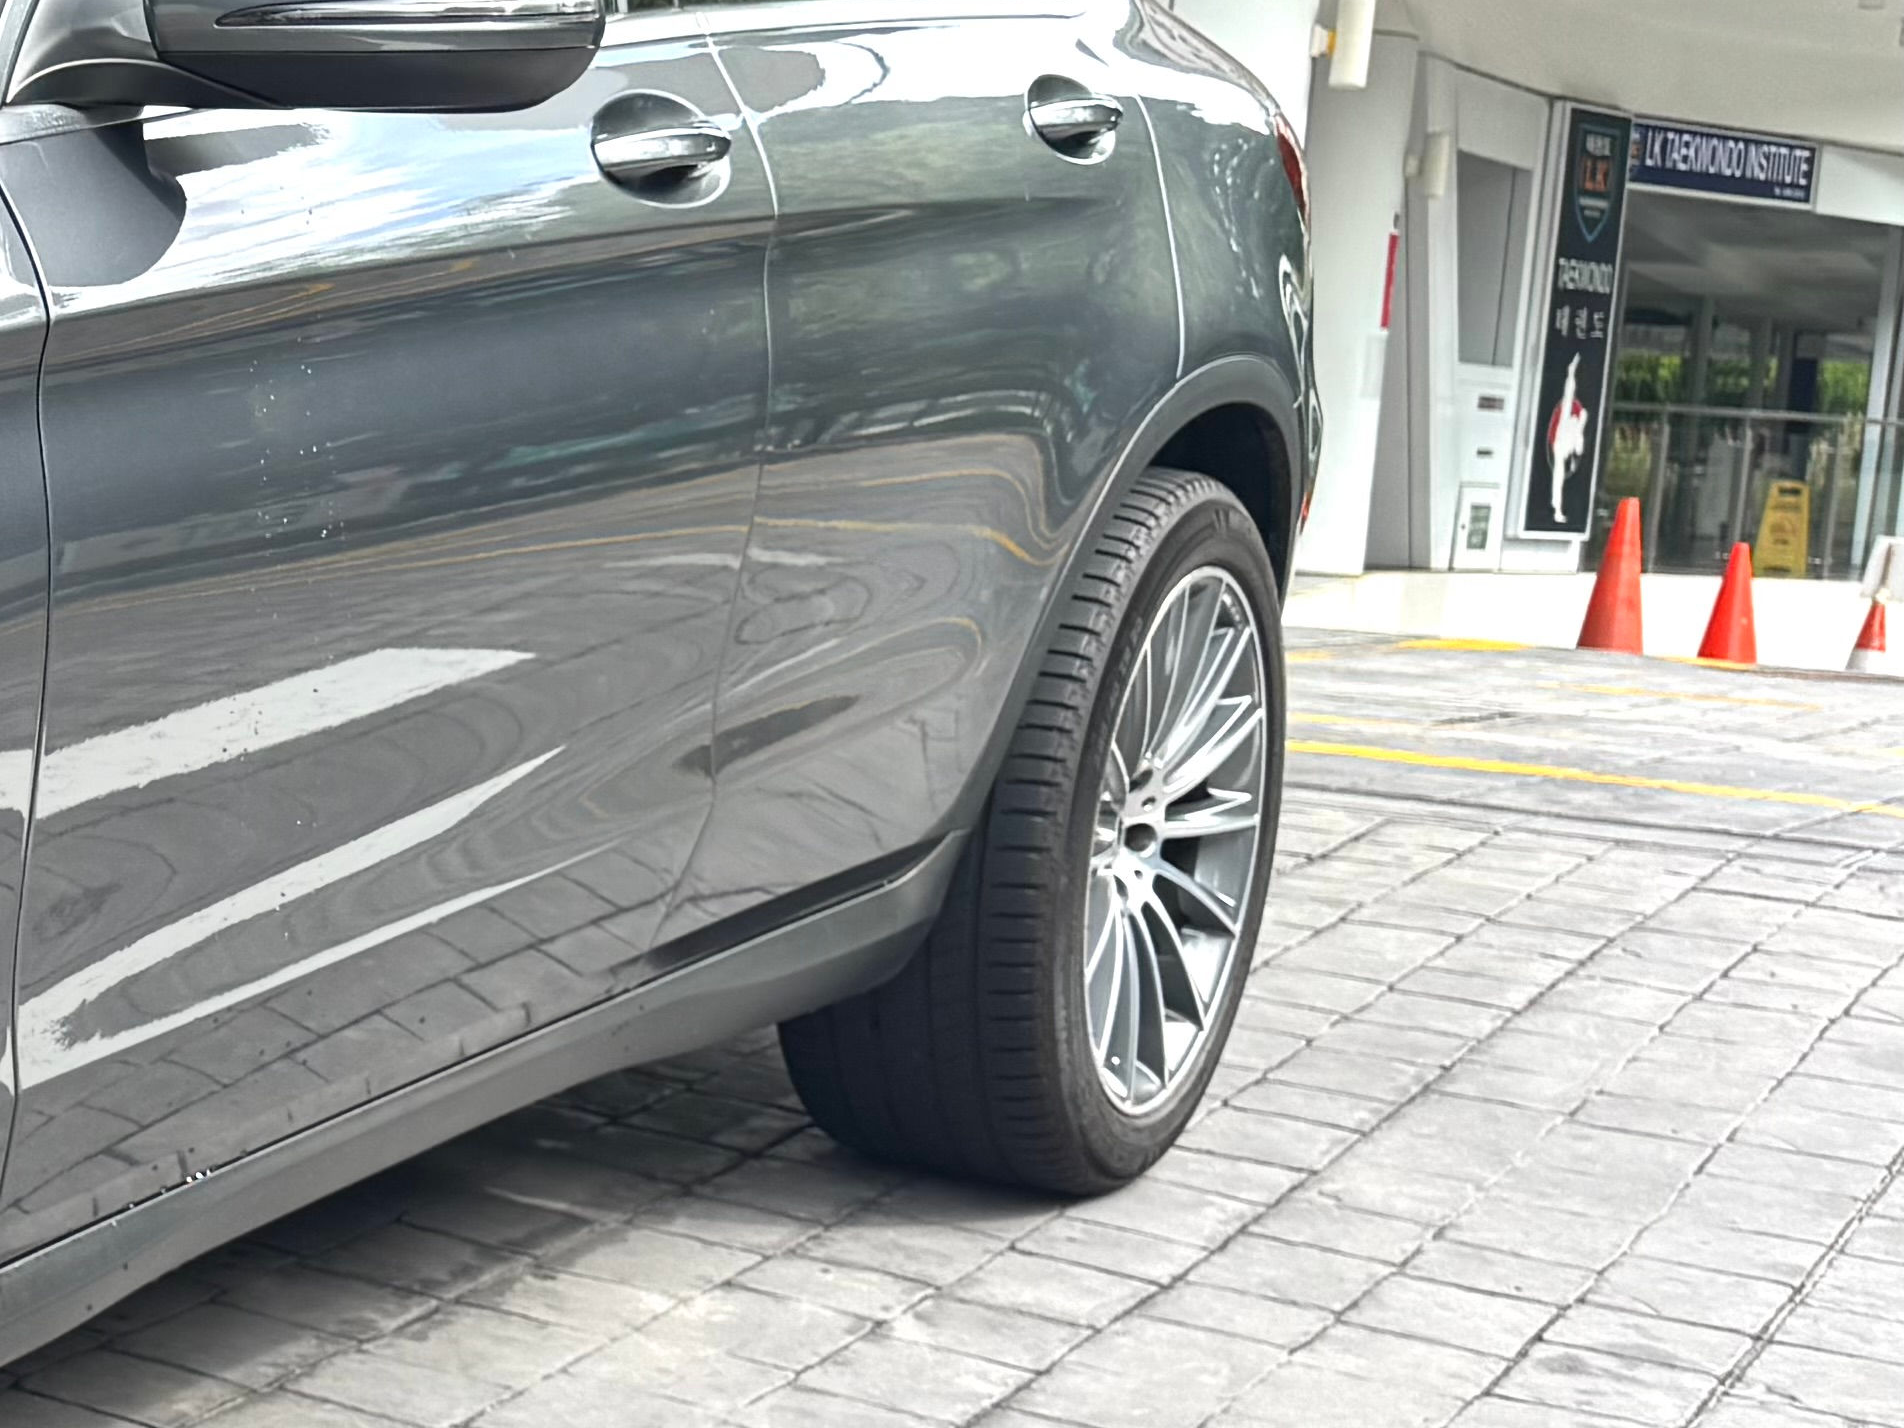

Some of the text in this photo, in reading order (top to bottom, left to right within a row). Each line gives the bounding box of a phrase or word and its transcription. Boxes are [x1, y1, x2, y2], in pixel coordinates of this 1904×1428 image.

[1645, 128, 1665, 167] LK
[1665, 131, 1745, 178] TAEKWONDO
[1745, 140, 1811, 186] INSTITUTE
